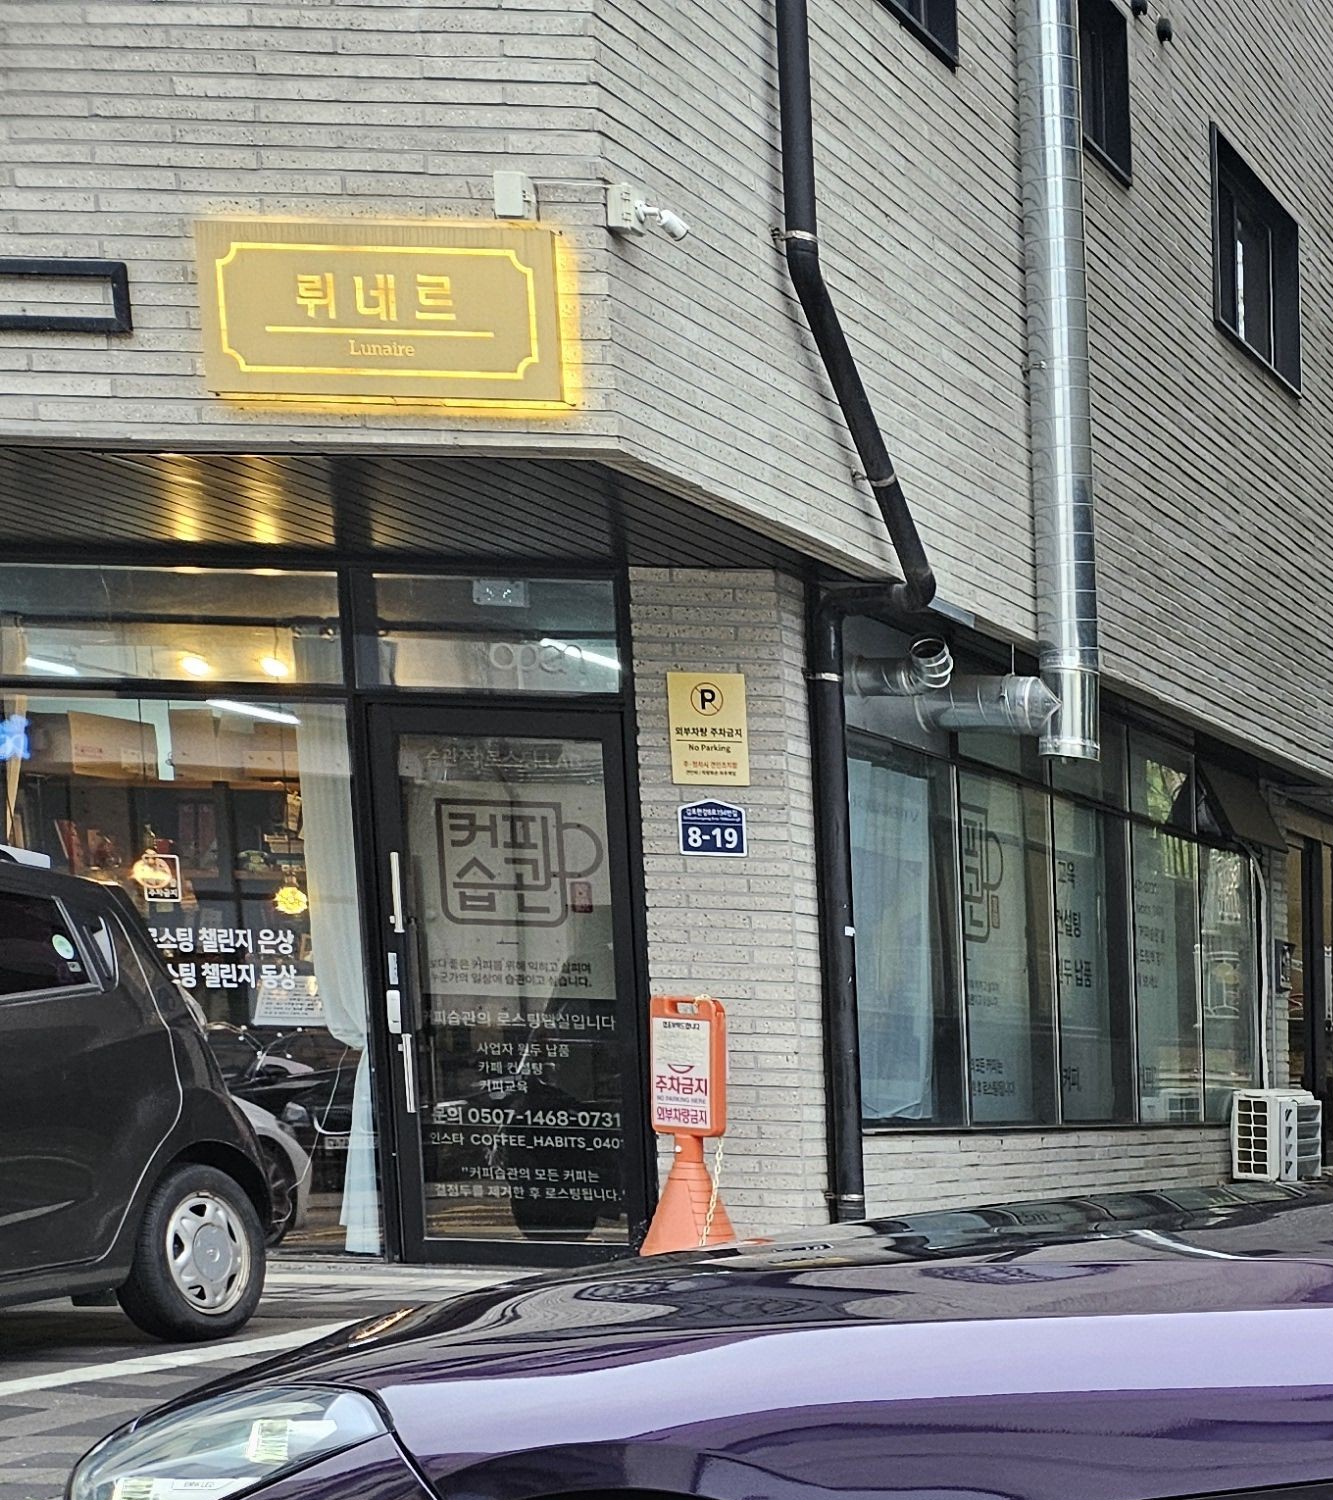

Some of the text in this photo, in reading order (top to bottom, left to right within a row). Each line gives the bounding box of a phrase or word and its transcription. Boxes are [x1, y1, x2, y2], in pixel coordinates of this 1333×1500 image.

[349, 339, 416, 357] Lunaire
[710, 727, 743, 739] 주차금지
[688, 743, 731, 754] No Parking
[687, 826, 739, 849] 8-19
[199, 927, 254, 954] 첼린지
[258, 929, 296, 955] 은상
[201, 963, 256, 989] 첼린지
[260, 965, 298, 990] 동상
[431, 1010, 491, 1028] 피습관의
[476, 1042, 514, 1056] 사업자
[478, 1061, 502, 1075] 카페
[655, 1075, 708, 1097] 주차금지
[432, 1106, 622, 1128] 문의 0507-1468-0731
[656, 1106, 708, 1125] 외부차량금지
[431, 1132, 624, 1151] 인스타 COFFEE_HABITS_040
[535, 1168, 559, 1182] 모든
[563, 1169, 600, 1183] 커피는
